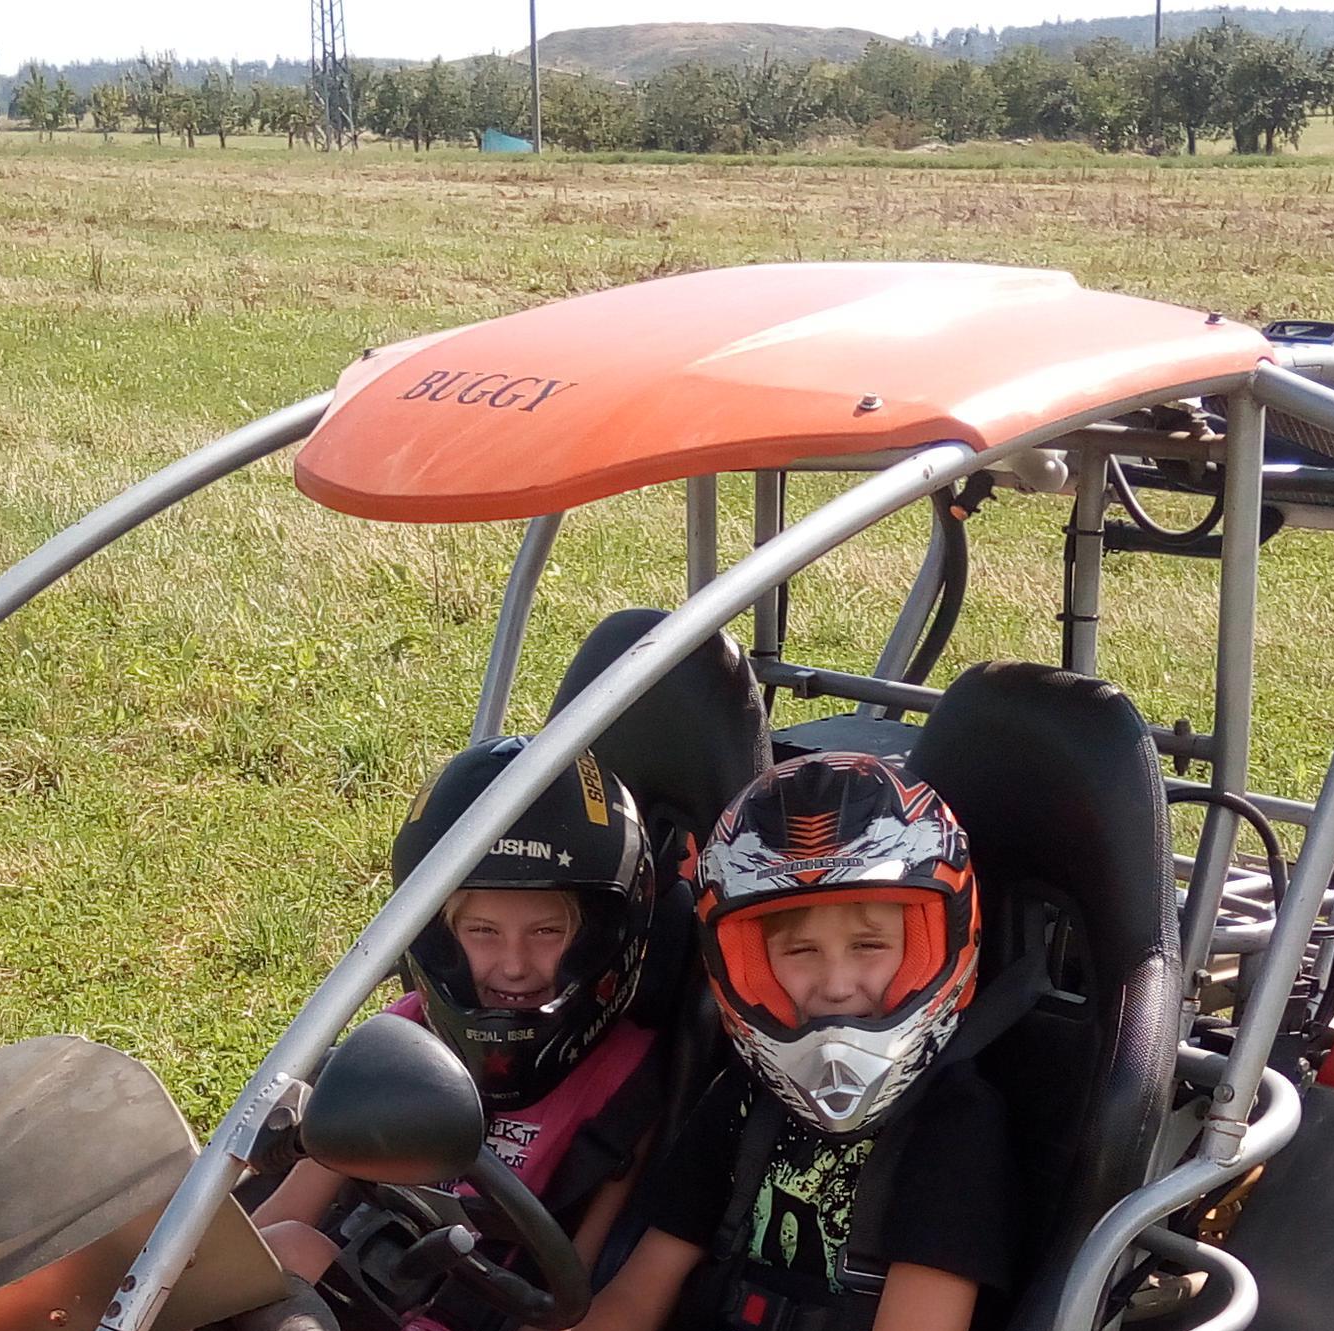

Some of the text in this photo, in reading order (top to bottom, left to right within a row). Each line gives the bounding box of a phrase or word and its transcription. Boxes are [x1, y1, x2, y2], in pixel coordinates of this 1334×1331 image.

[396, 370, 579, 412] BUGGY
[578, 757, 603, 804] SPEC
[489, 838, 552, 860] USHIN
[466, 1027, 535, 1042] SPECIAL ISSUE
